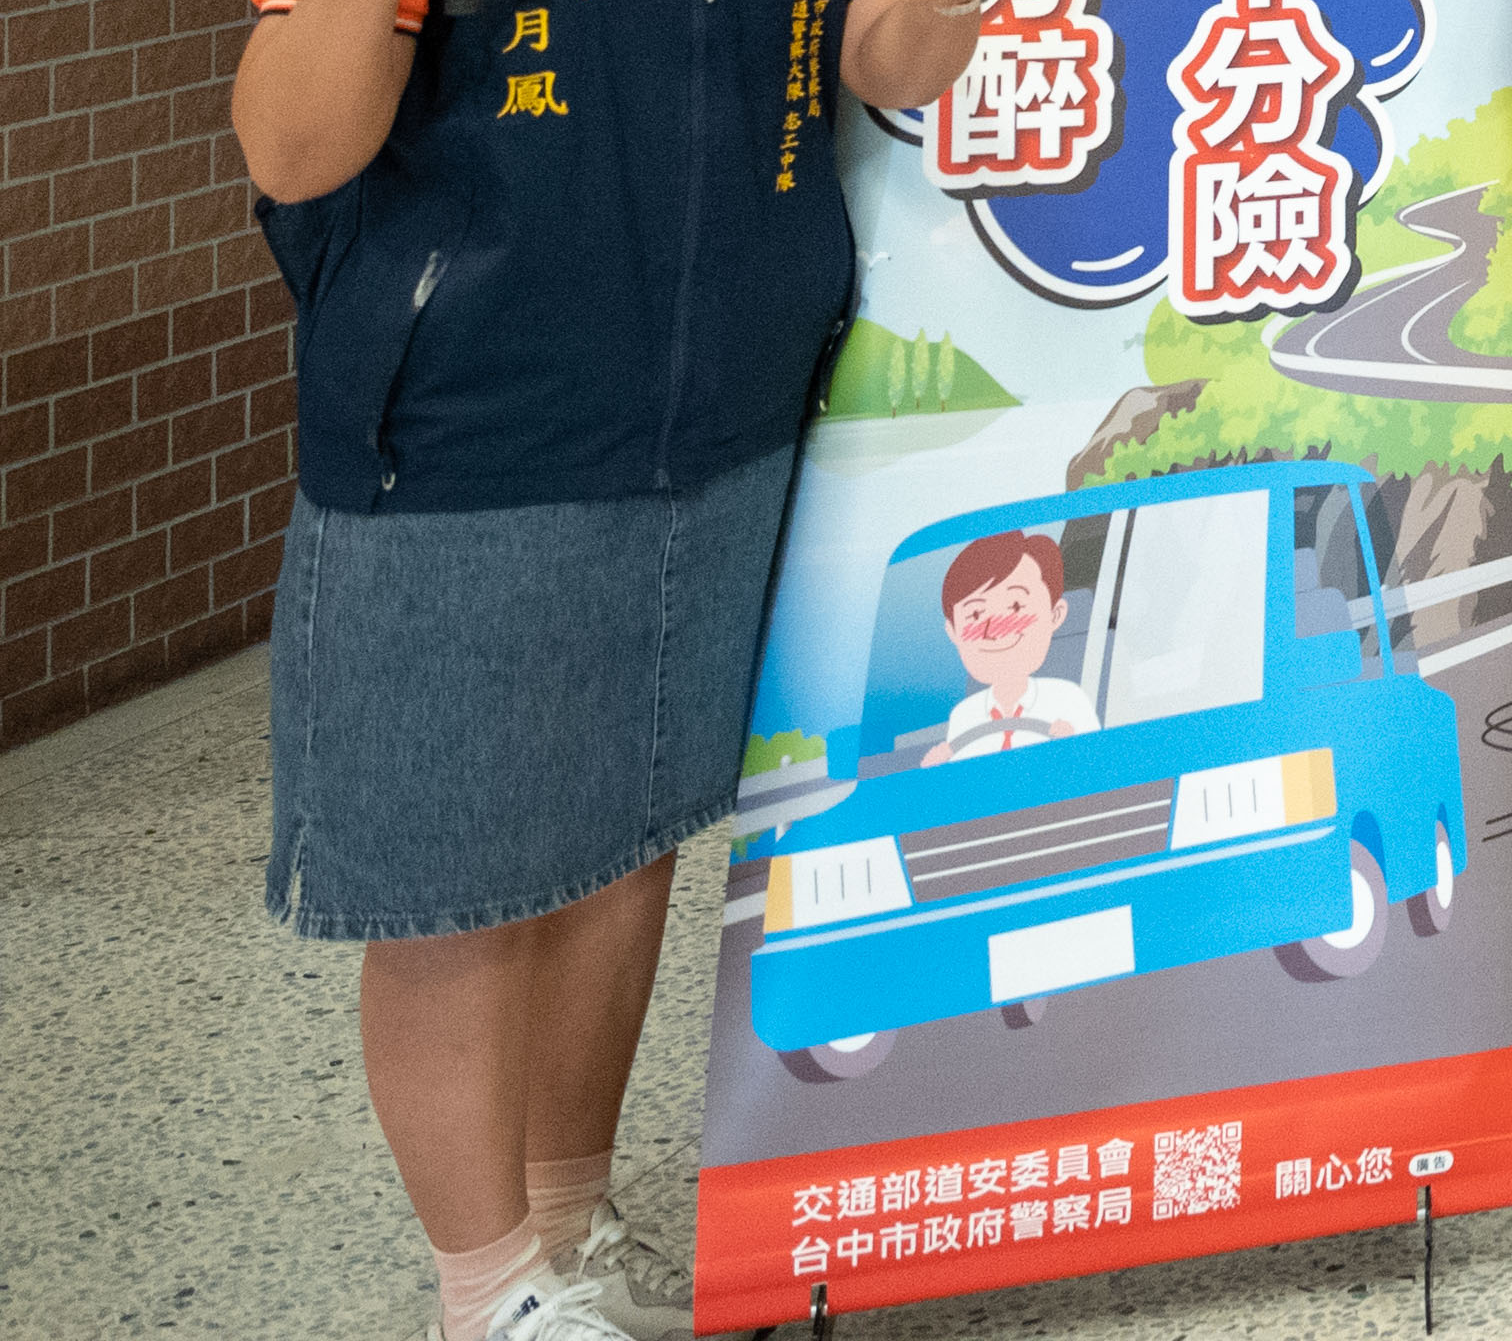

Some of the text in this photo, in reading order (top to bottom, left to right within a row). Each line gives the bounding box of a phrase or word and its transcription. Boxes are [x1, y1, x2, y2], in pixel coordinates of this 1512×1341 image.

[793, 1136, 1135, 1226] 交通部道安委員會
[1275, 1145, 1392, 1198] 關心您
[1415, 1154, 1447, 1173] 廣告
[791, 1187, 1132, 1277] 台中市政府警察局
